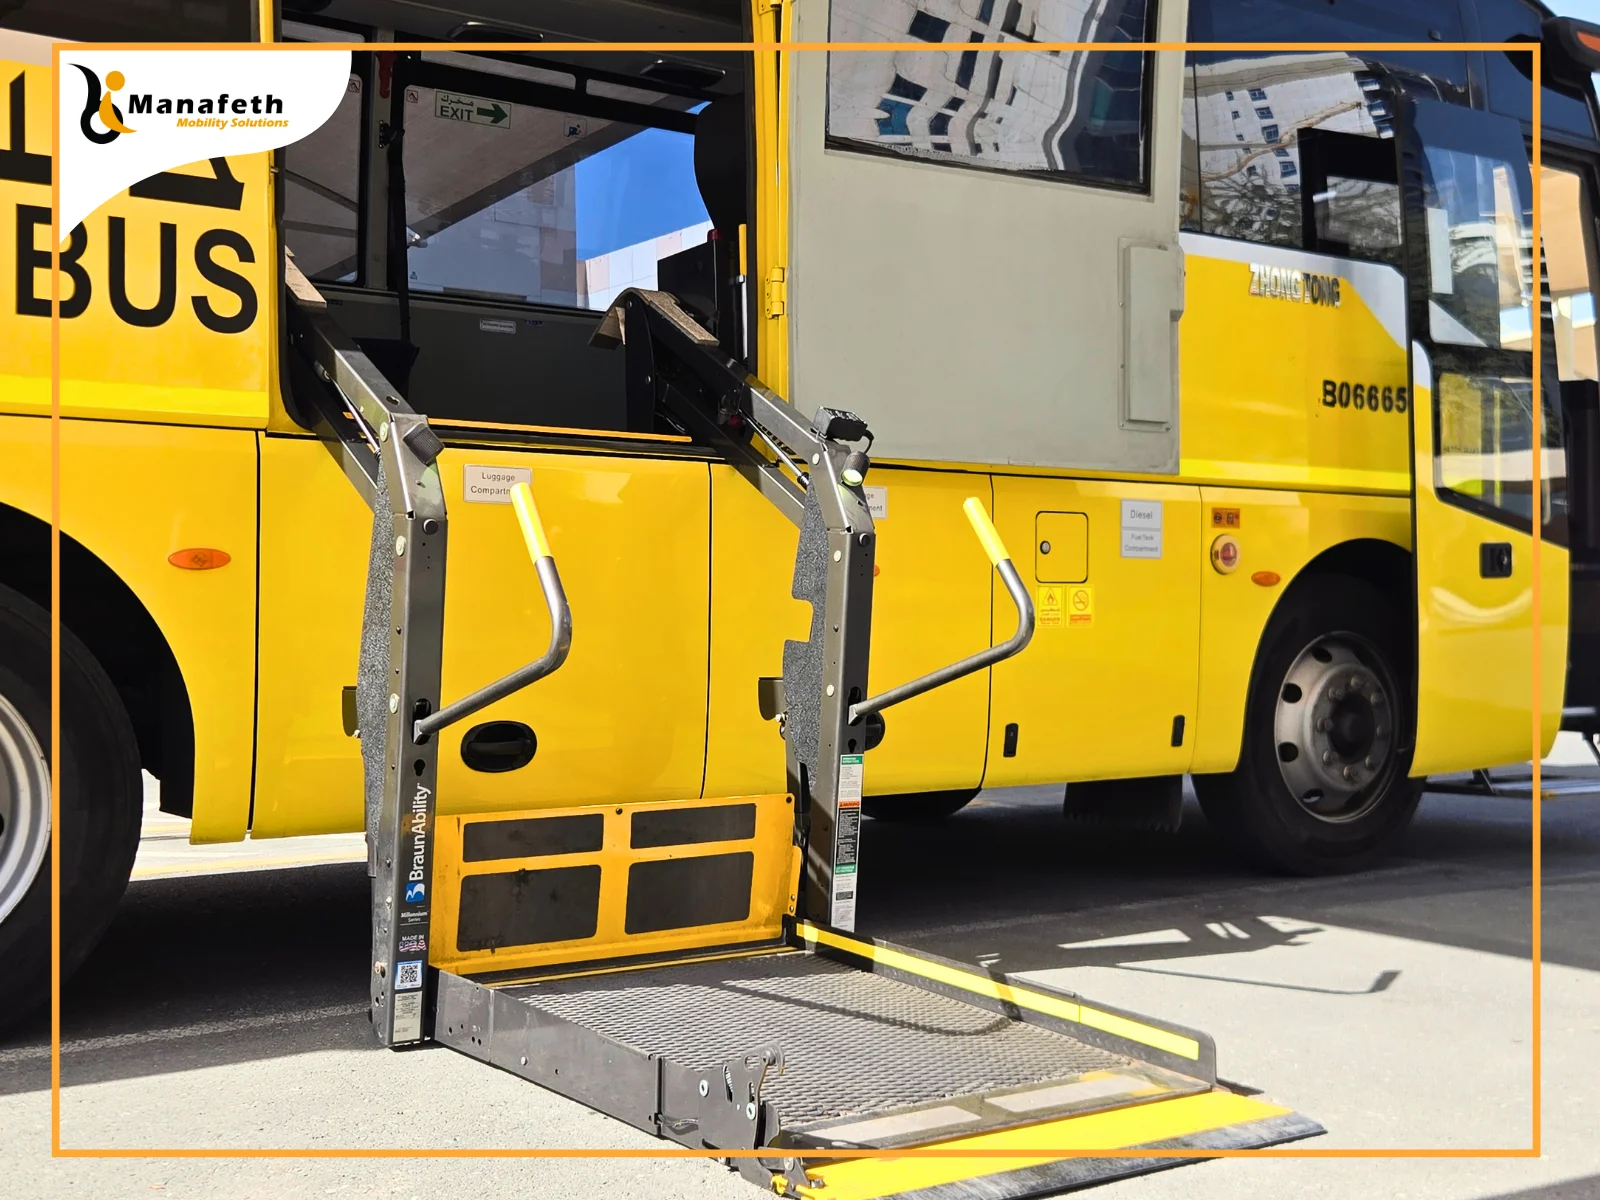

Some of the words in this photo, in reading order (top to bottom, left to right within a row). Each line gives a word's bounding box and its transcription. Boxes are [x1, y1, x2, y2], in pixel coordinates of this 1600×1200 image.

[440, 105, 474, 121] EXIT
[16, 203, 258, 333] BUS
[1249, 262, 1301, 303] ZHONG
[1302, 272, 1341, 308] TONG
[1322, 379, 1407, 414] B06665
[481, 472, 516, 482] Luggage
[1130, 509, 1153, 519] Diesel
[408, 784, 432, 881] BraunAbility
